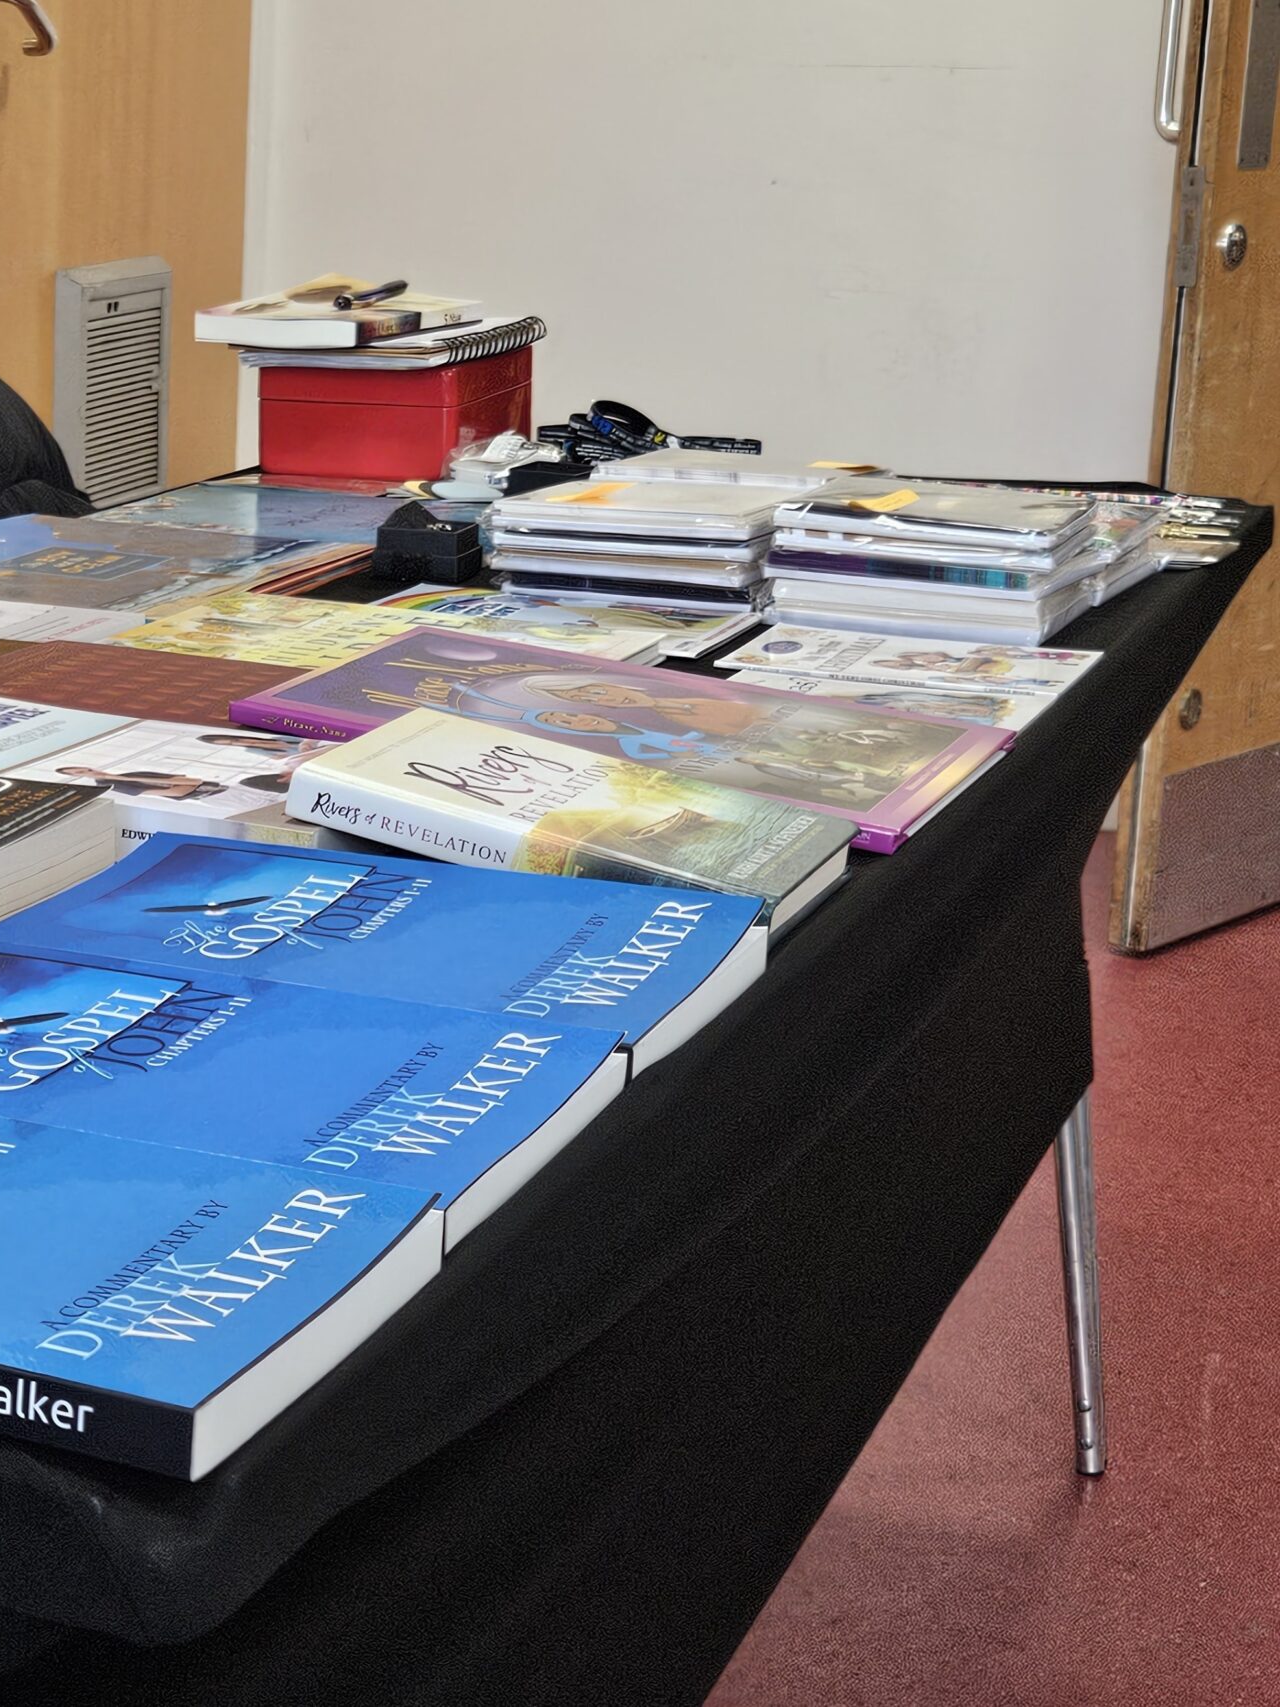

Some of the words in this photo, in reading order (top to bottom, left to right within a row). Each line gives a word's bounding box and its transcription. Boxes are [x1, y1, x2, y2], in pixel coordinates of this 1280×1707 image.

[2, 788, 31, 802] THE
[404, 745, 575, 807] Rivers
[510, 760, 620, 823] REVELATION
[311, 792, 361, 825] Rivers
[364, 812, 376, 825] of
[380, 815, 507, 865] REVELATION
[161, 920, 228, 954] The
[199, 873, 369, 959] GOSPEL
[297, 870, 422, 943] JOHN
[348, 894, 413, 941] CHAPTERS
[586, 911, 609, 928] BY
[502, 951, 616, 1018] DEREK
[560, 900, 713, 1007] WALKER
[88, 986, 237, 1073] JOHN
[146, 1018, 227, 1068] CHAPTERS
[302, 1086, 446, 1171] DEREK
[303, 1138, 321, 1148] A
[316, 1053, 427, 1143] COMMENTARY
[420, 1041, 445, 1059] BY
[372, 1031, 563, 1156] WALKER
[40, 1318, 68, 1332] A
[58, 1219, 206, 1320] COMMENTARY
[195, 1199, 230, 1220] BY
[120, 1188, 367, 1343] WALKER
[34, 1252, 222, 1361] DEREK
